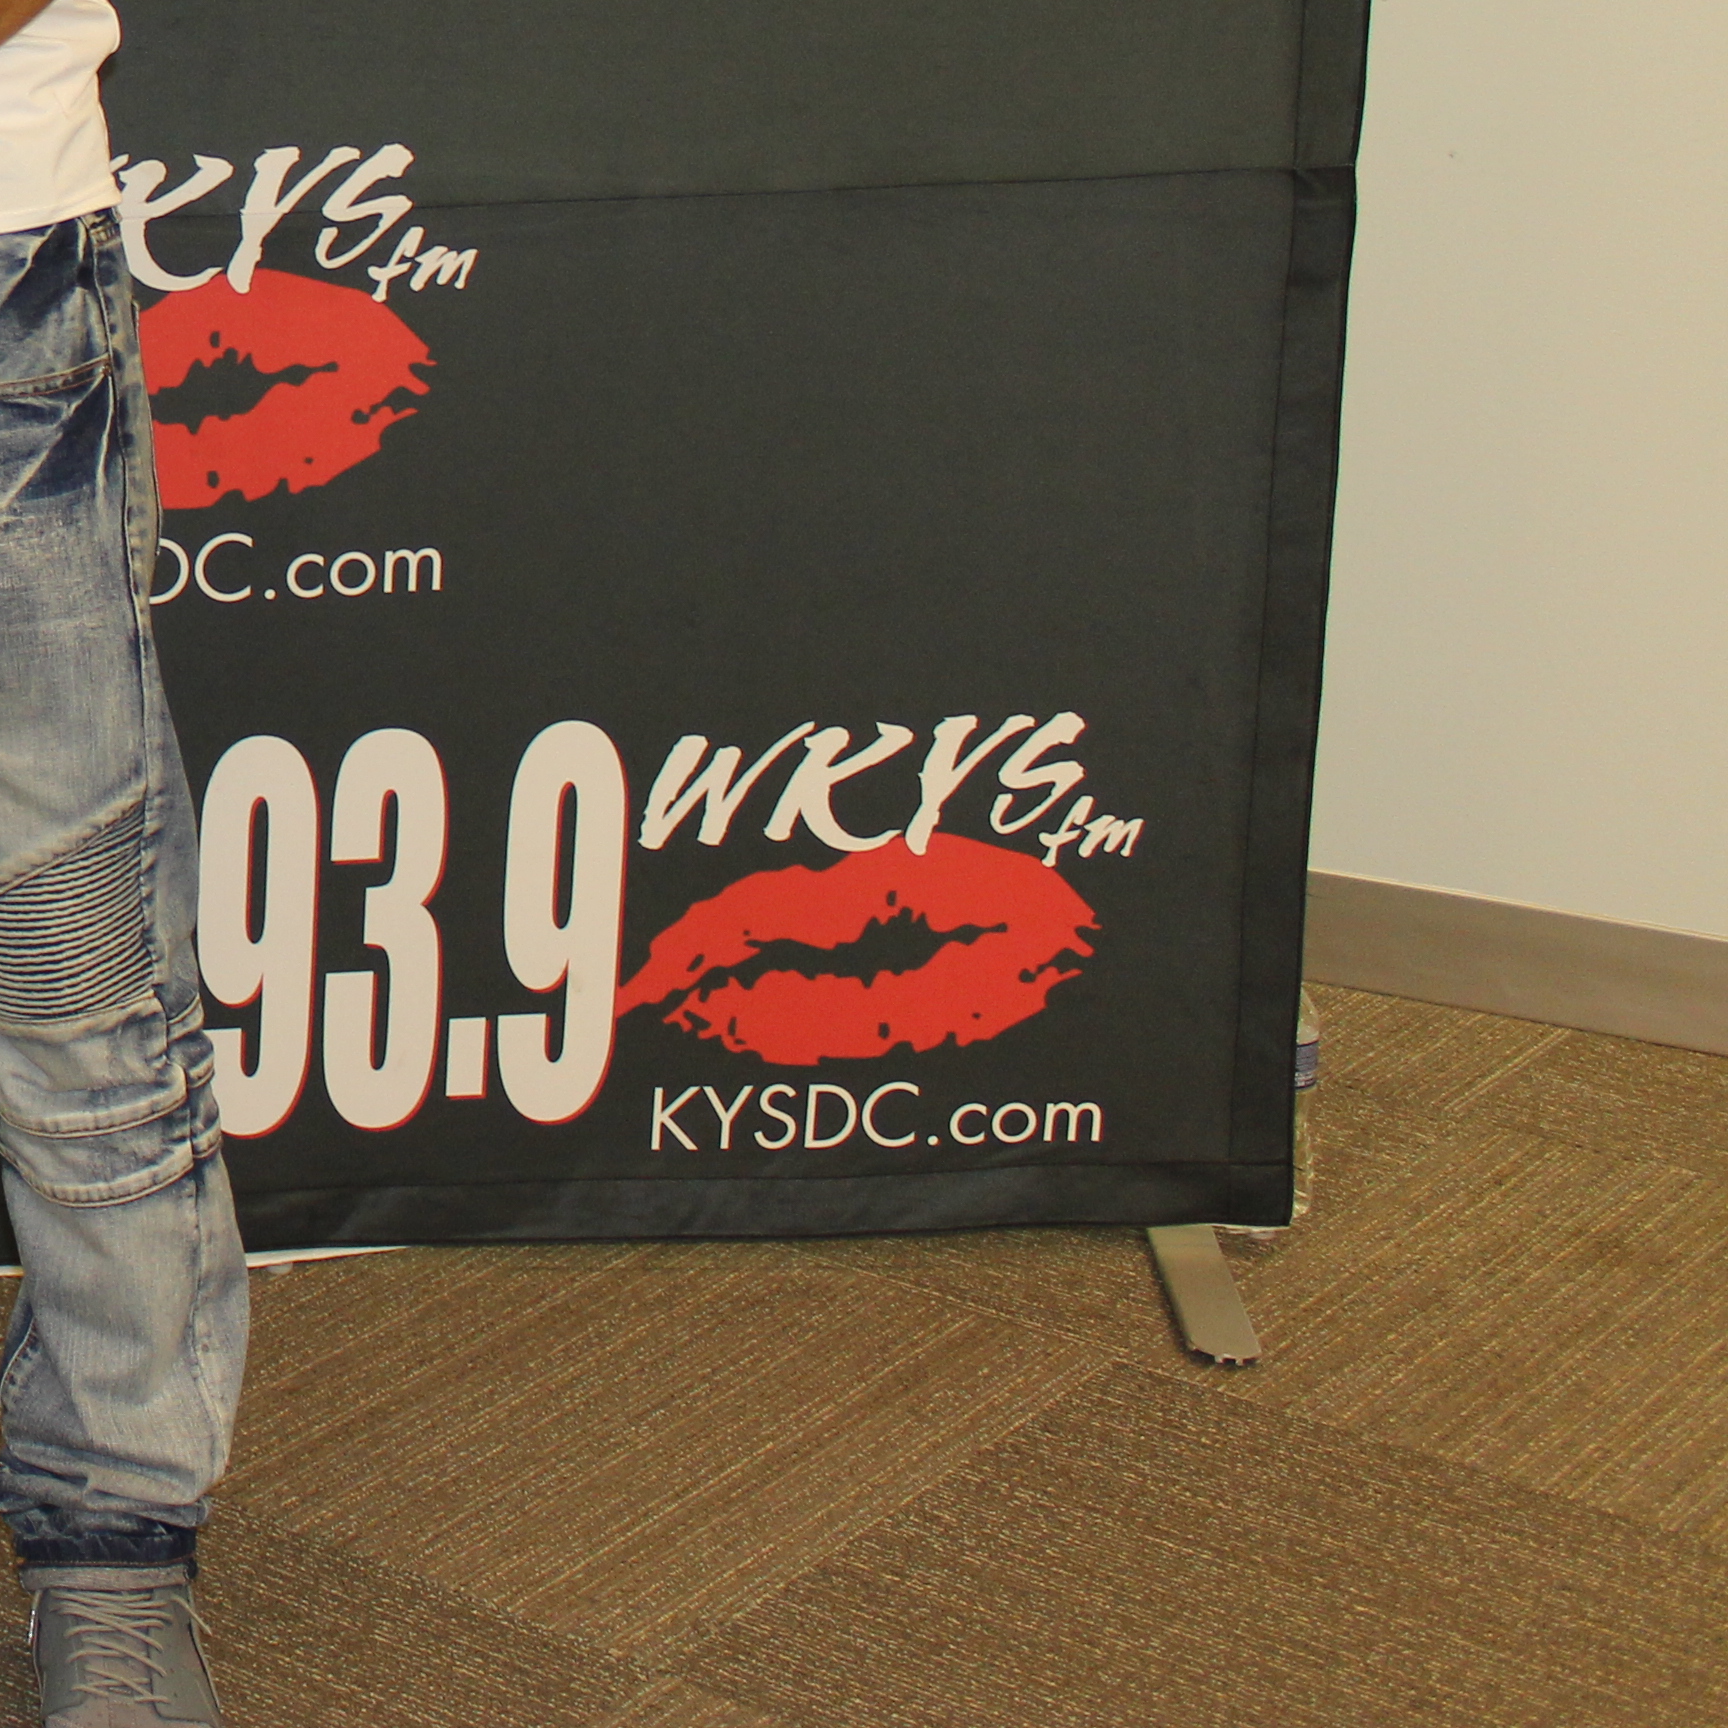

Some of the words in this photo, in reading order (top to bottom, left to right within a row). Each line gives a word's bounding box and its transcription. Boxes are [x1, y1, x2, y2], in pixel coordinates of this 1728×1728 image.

[110, 142, 415, 294] KYS
[149, 531, 443, 604] DC.com
[638, 711, 1086, 856] WKYS
[197, 719, 629, 1139] 93.9
[648, 1081, 1103, 1152] KYSDC.com
